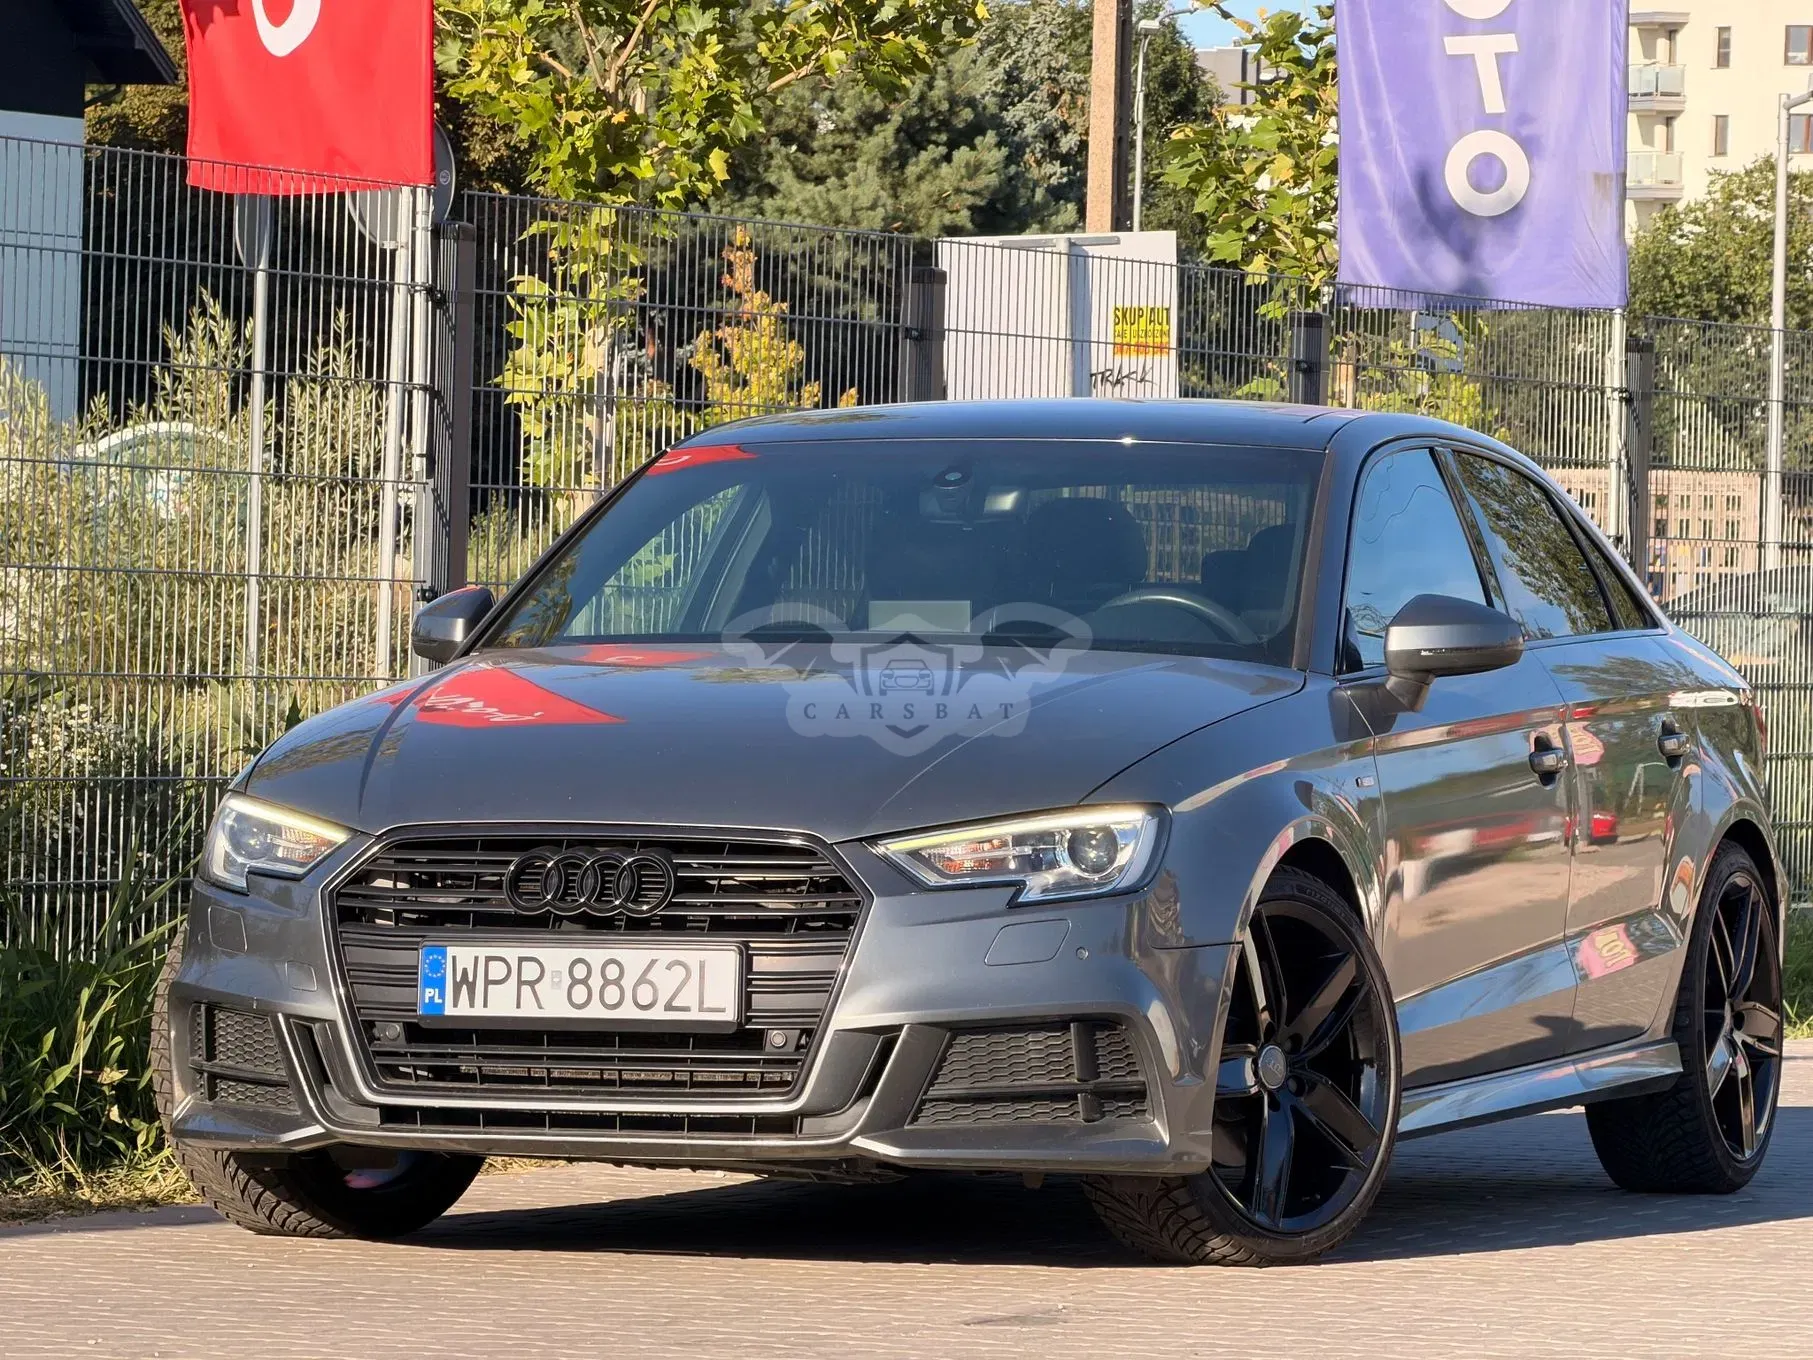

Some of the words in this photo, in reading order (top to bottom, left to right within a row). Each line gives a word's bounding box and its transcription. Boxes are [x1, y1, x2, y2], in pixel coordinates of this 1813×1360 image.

[1443, 0, 1530, 217] TO
[1114, 307, 1144, 326] SKUP
[424, 988, 443, 1004] PL
[451, 955, 546, 1010] WPR
[566, 957, 727, 1013] 8862L
